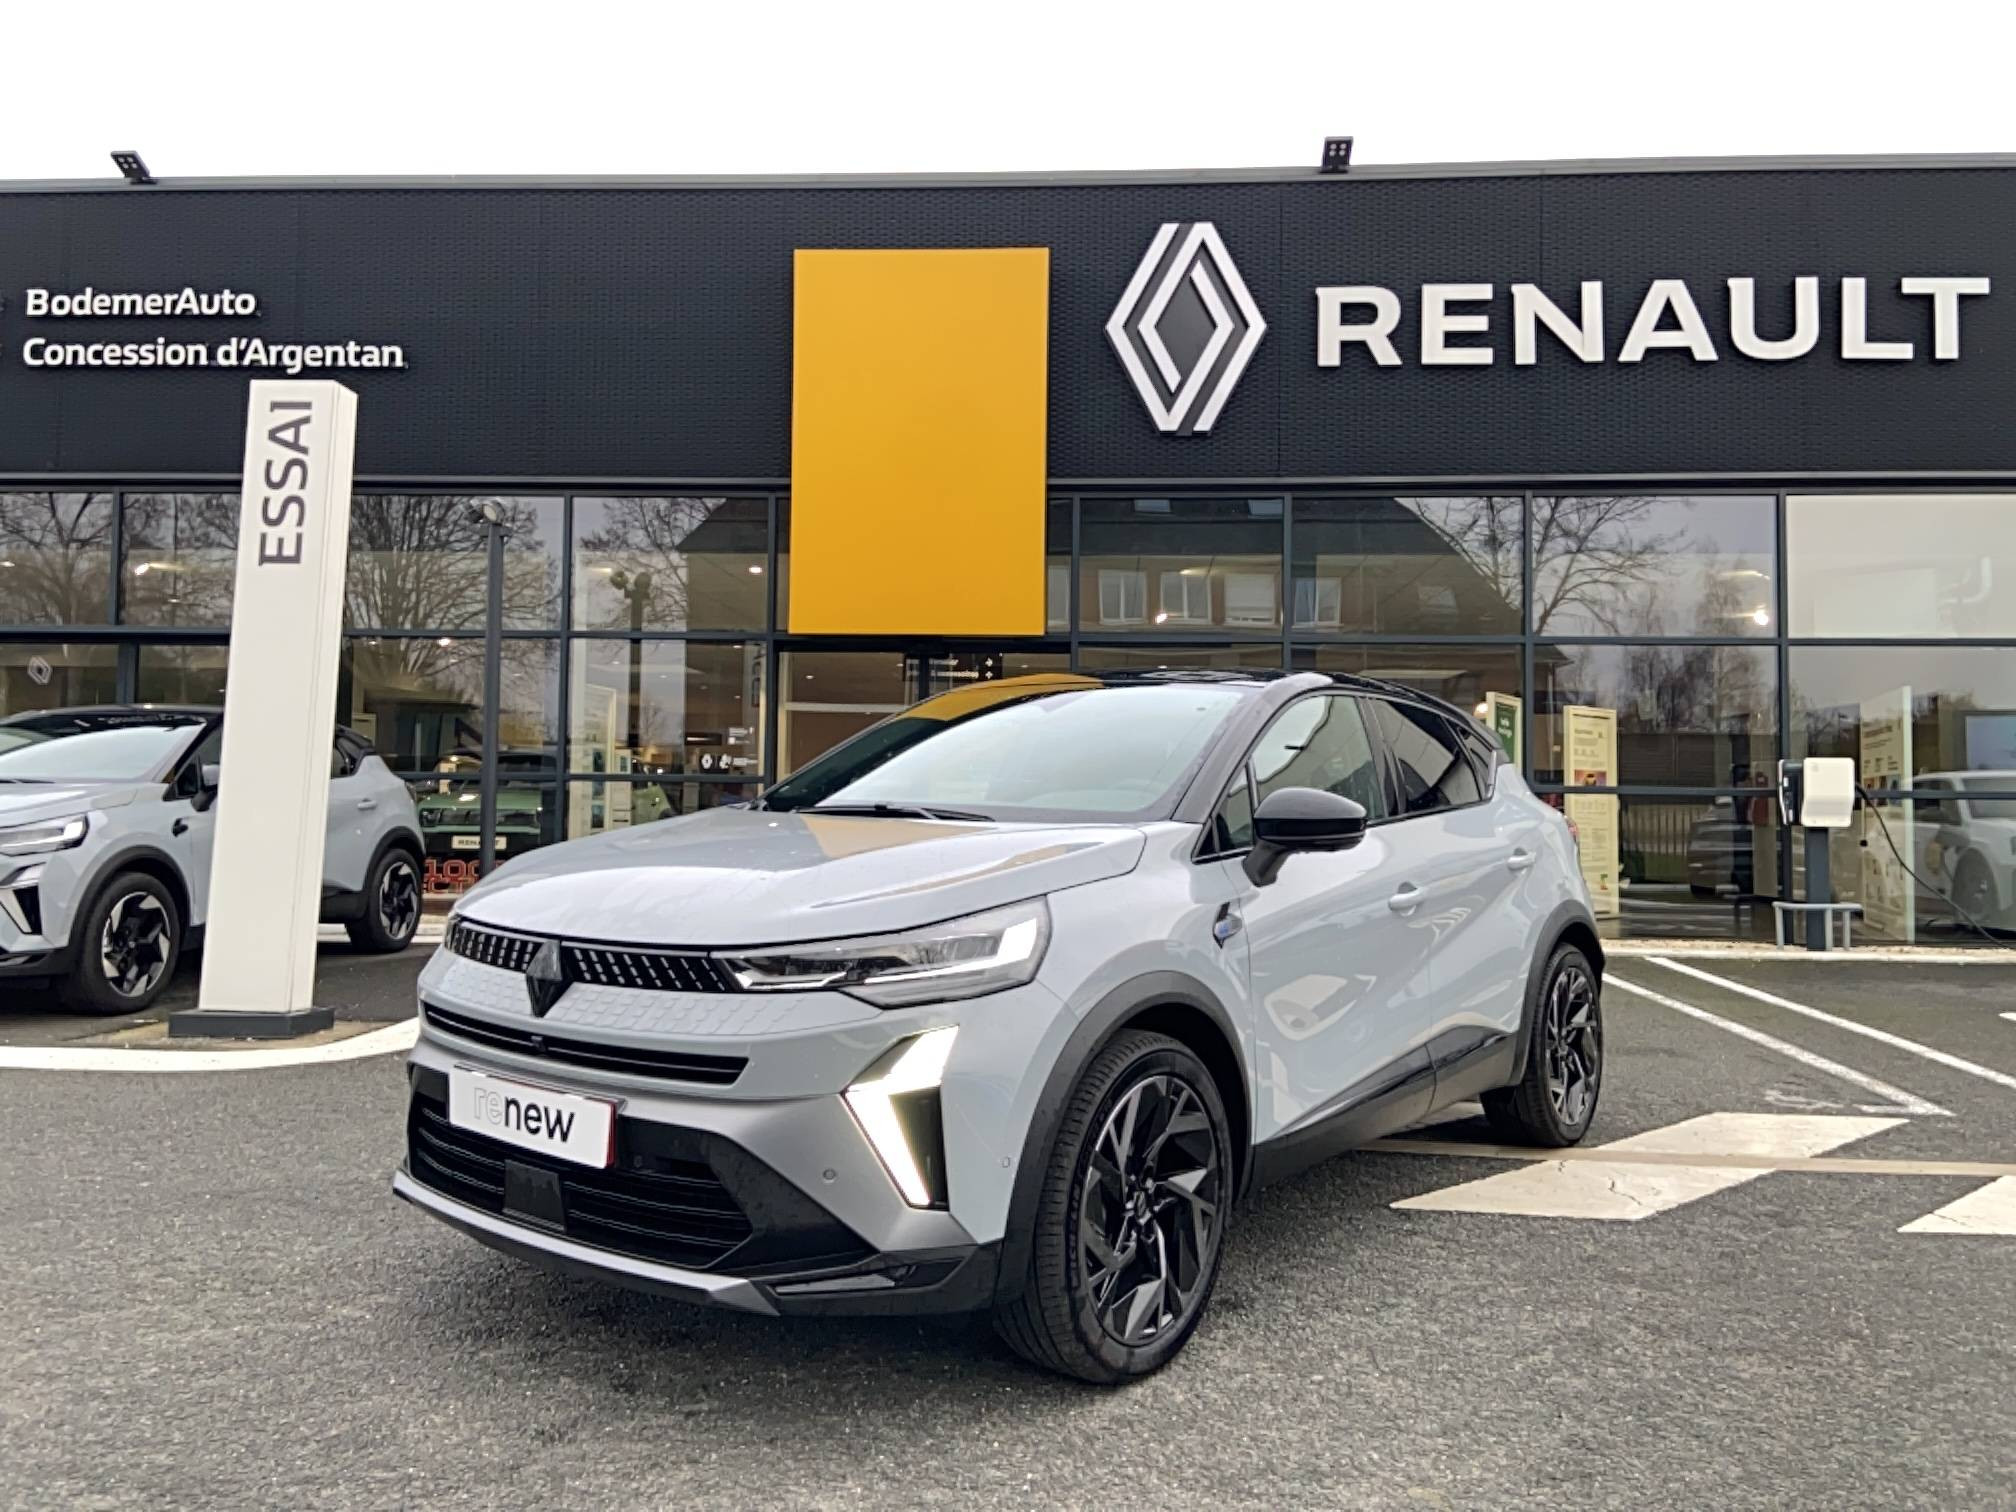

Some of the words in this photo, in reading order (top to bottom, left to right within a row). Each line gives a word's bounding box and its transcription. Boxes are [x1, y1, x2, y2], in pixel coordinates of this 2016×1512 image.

[26, 287, 256, 316] BodemerAuto
[1315, 276, 1990, 367] RENAULT
[23, 336, 209, 366] Concession
[258, 400, 312, 567] ESSAI
[473, 1087, 576, 1143] renew
